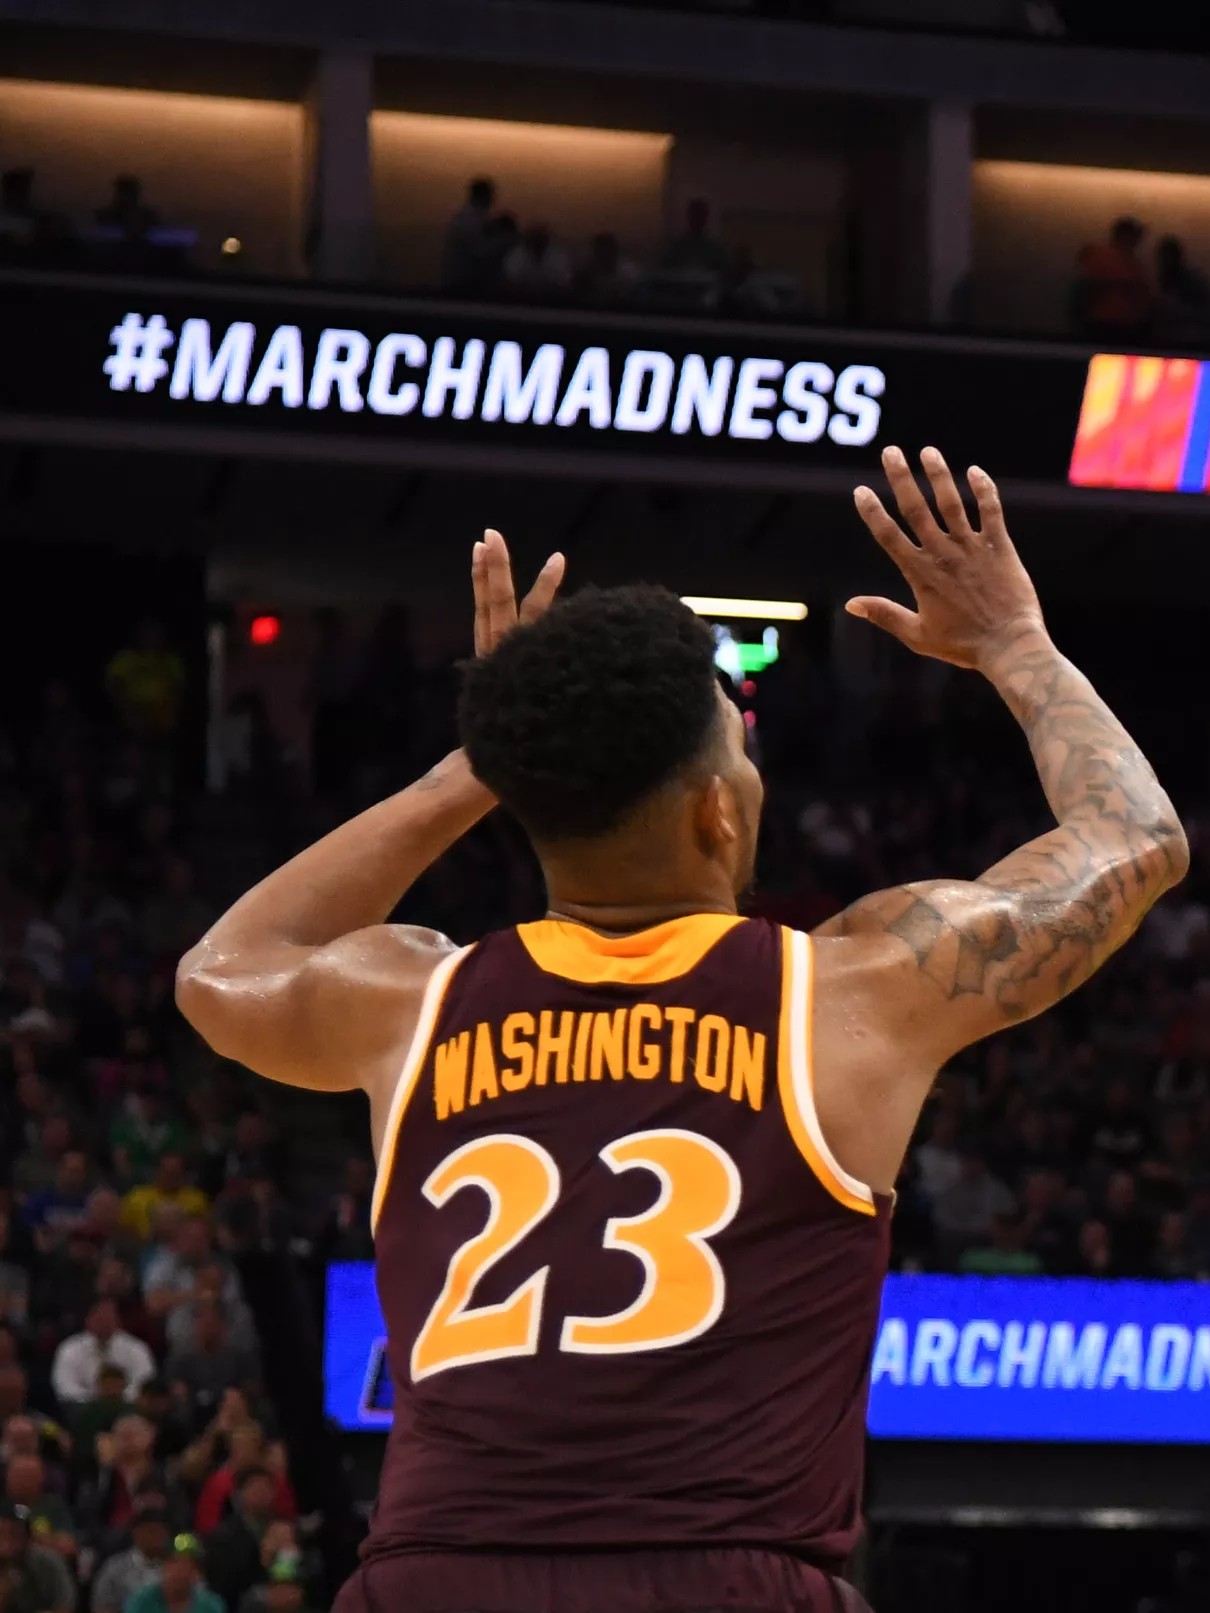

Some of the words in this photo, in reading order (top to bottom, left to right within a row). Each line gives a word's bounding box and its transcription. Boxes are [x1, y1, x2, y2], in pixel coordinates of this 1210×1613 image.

[103, 312, 886, 446] #MARCHMADNESS
[434, 1003, 766, 1121] WASHINGTON
[410, 1128, 742, 1384] 23
